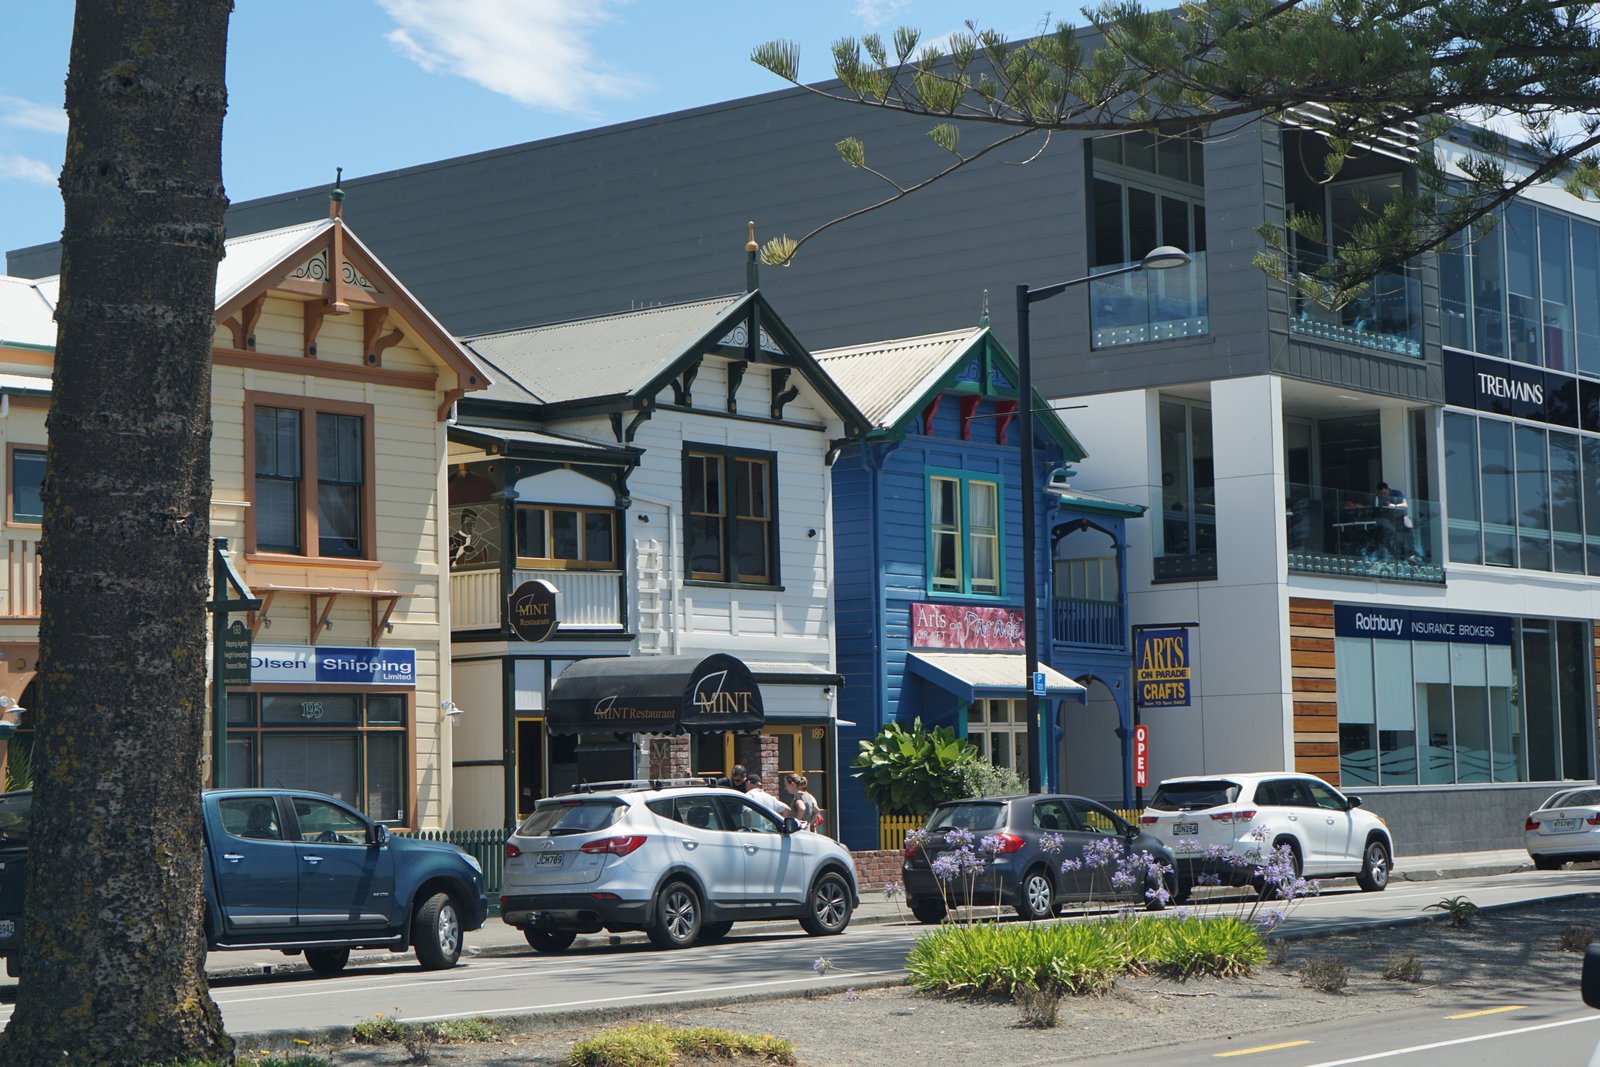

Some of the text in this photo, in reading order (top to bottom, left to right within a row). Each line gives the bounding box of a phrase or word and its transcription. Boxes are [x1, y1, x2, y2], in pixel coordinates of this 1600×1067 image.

[1477, 373, 1544, 405] TREMAINS
[519, 603, 549, 616] MINT
[232, 624, 242, 635] 193
[520, 618, 550, 626] Restaurant
[917, 607, 1021, 642] Arts on Parade
[1355, 612, 1495, 638] Rothbury INSURANCE BROKERS
[916, 630, 946, 640] CRAFT
[1142, 636, 1185, 670] ARTS
[250, 656, 412, 674] Olsen Shipping
[1141, 669, 1187, 679] ON PARADE
[383, 673, 412, 681] Limited
[1143, 682, 1186, 700] CRAFTS
[301, 701, 324, 719] 193
[700, 692, 752, 714] MINT
[597, 707, 676, 720] MINT Restaurant
[812, 728, 825, 740] 189
[1137, 728, 1145, 784] OPEN
